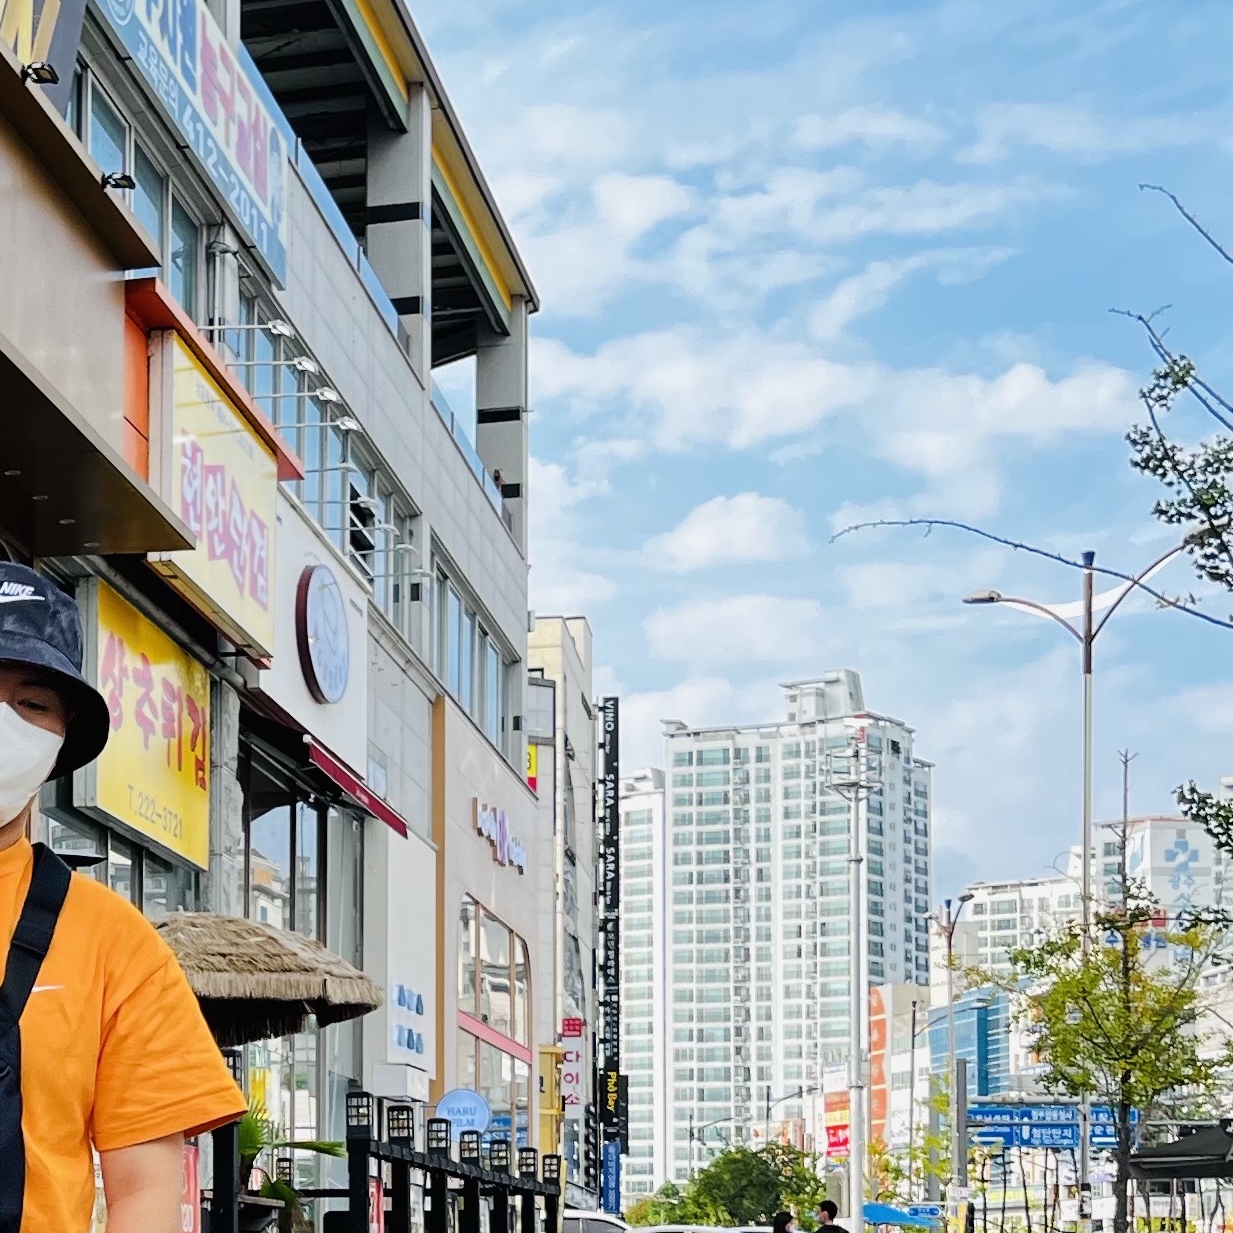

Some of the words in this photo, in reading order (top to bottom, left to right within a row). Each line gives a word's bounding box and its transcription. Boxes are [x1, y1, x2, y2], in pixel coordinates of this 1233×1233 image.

[182, 105, 268, 255] 412-2011
[0, 581, 35, 596] NIKE
[100, 630, 207, 792] 상추튀김
[604, 700, 615, 732] VINO
[604, 772, 615, 807] SARA
[127, 783, 184, 841] T.222-3721
[605, 846, 616, 880] SARA
[562, 1050, 582, 1107] 다이소
[447, 1107, 477, 1116] HARU
